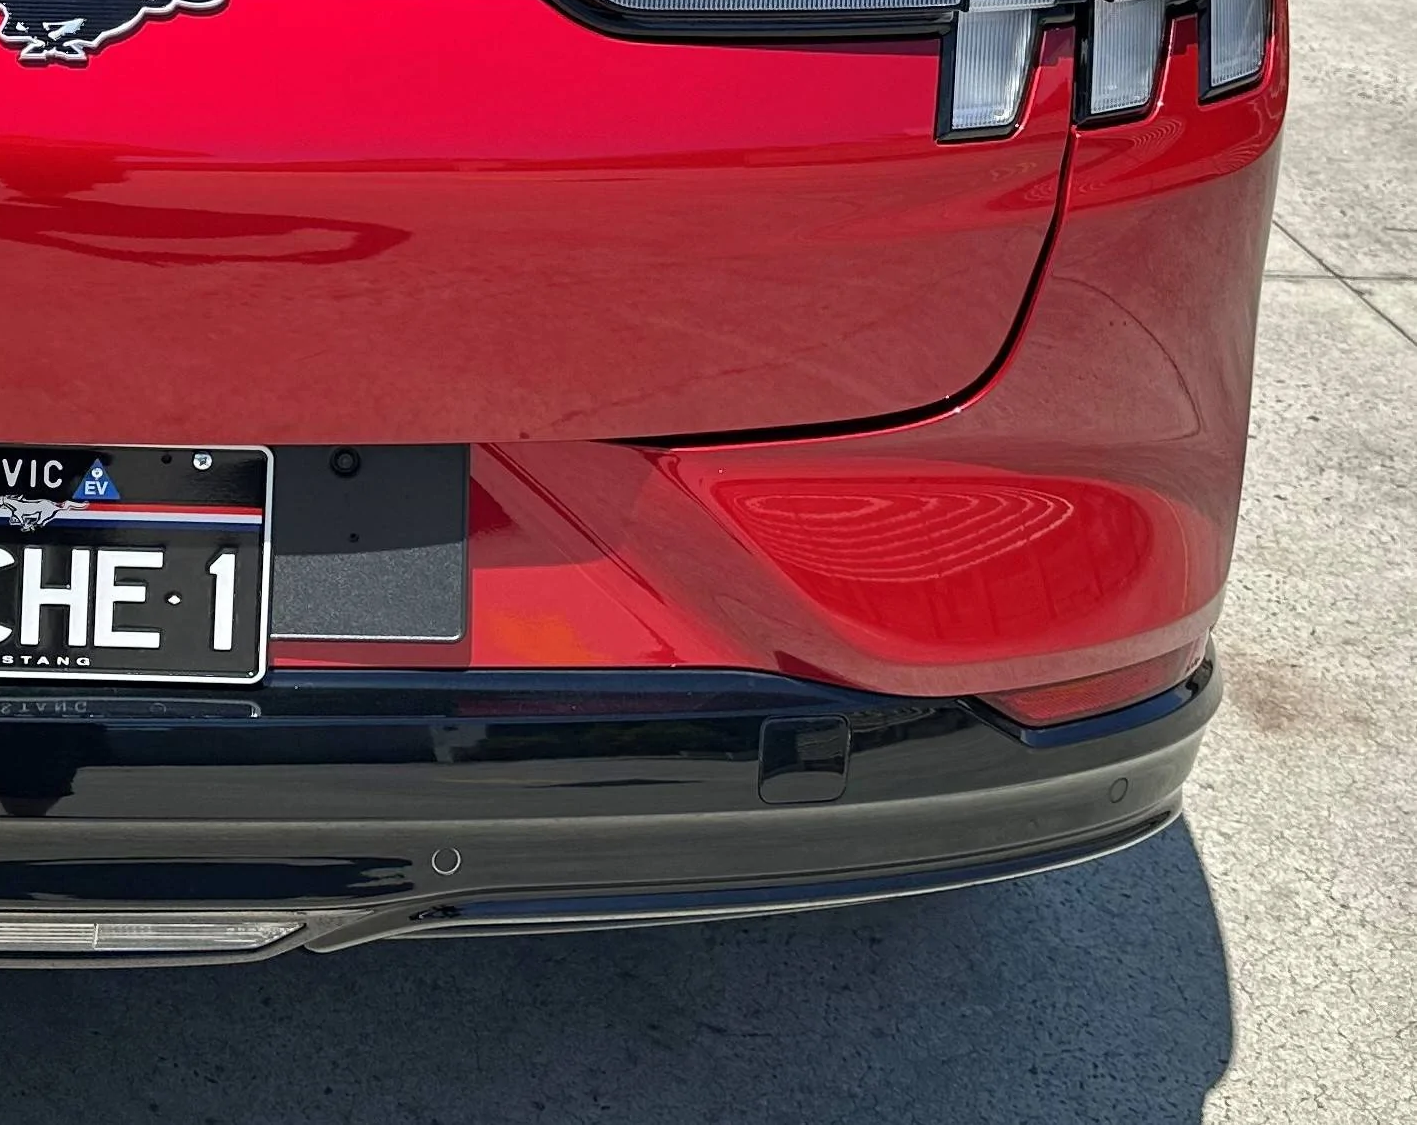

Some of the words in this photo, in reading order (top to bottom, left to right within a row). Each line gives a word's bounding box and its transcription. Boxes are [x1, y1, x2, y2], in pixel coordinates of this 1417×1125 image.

[2, 459, 63, 488] VIC
[84, 481, 108, 495] EV
[209, 554, 235, 651] 1
